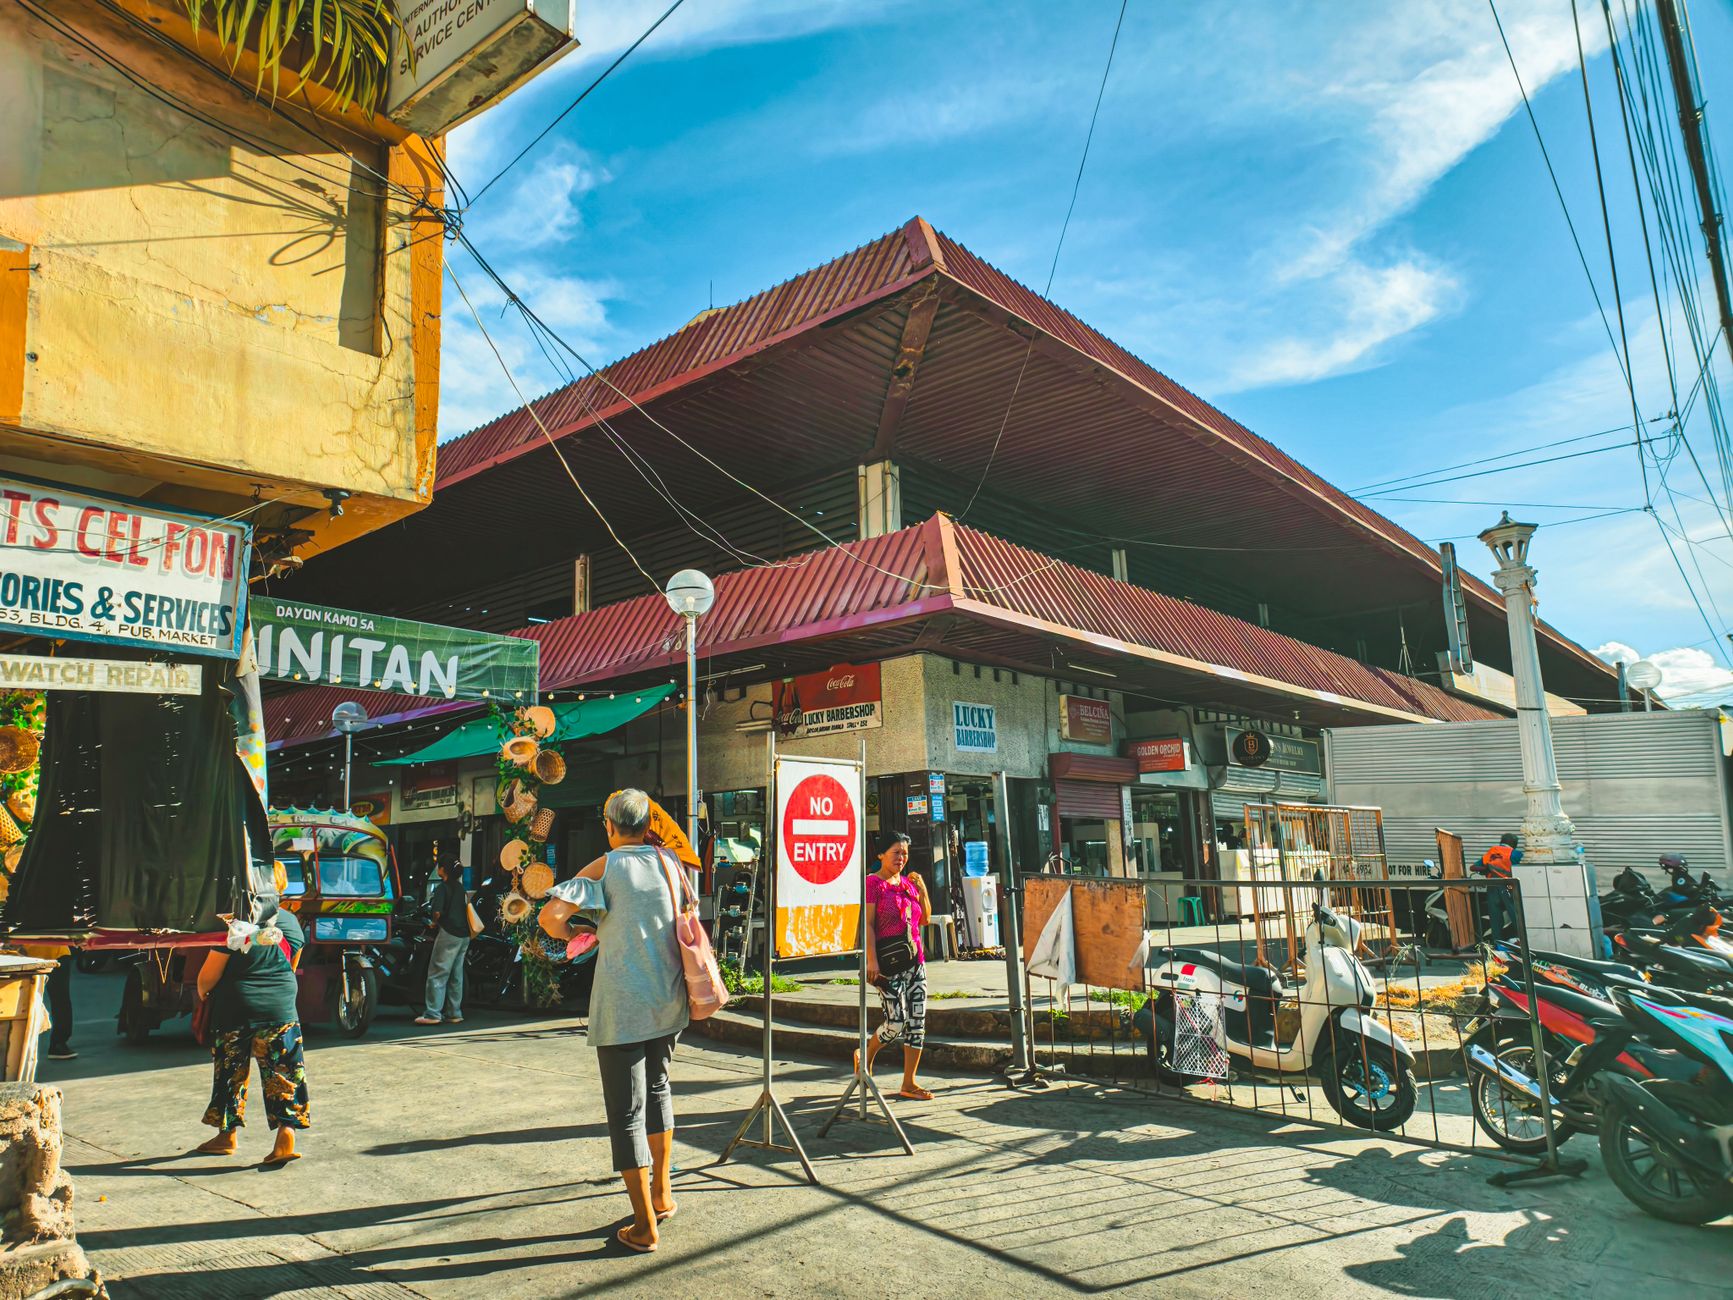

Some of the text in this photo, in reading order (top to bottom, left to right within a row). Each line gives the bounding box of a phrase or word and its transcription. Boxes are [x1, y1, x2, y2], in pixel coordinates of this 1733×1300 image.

[400, 21, 452, 75] SRVICE
[76, 506, 236, 579] CEL-FON
[0, 572, 233, 636] ORIES & SERVICES
[30, 612, 83, 630] BLDG.
[118, 624, 155, 640] PUB.
[159, 629, 217, 646] MARKET
[276, 605, 375, 632] DAYON KAMO SA
[0, 660, 190, 689] WATCH REPAIR
[804, 703, 875, 726] LUCKY BARBERSHOP
[954, 704, 994, 729] LUCKY
[956, 729, 996, 748] BARBERSHOP
[1136, 743, 1181, 756] GOLDEN ORCHID
[809, 796, 833, 816] NO
[793, 842, 847, 862] ENTRY
[1398, 864, 1411, 876] FOR
[1415, 865, 1431, 876] HIRE
